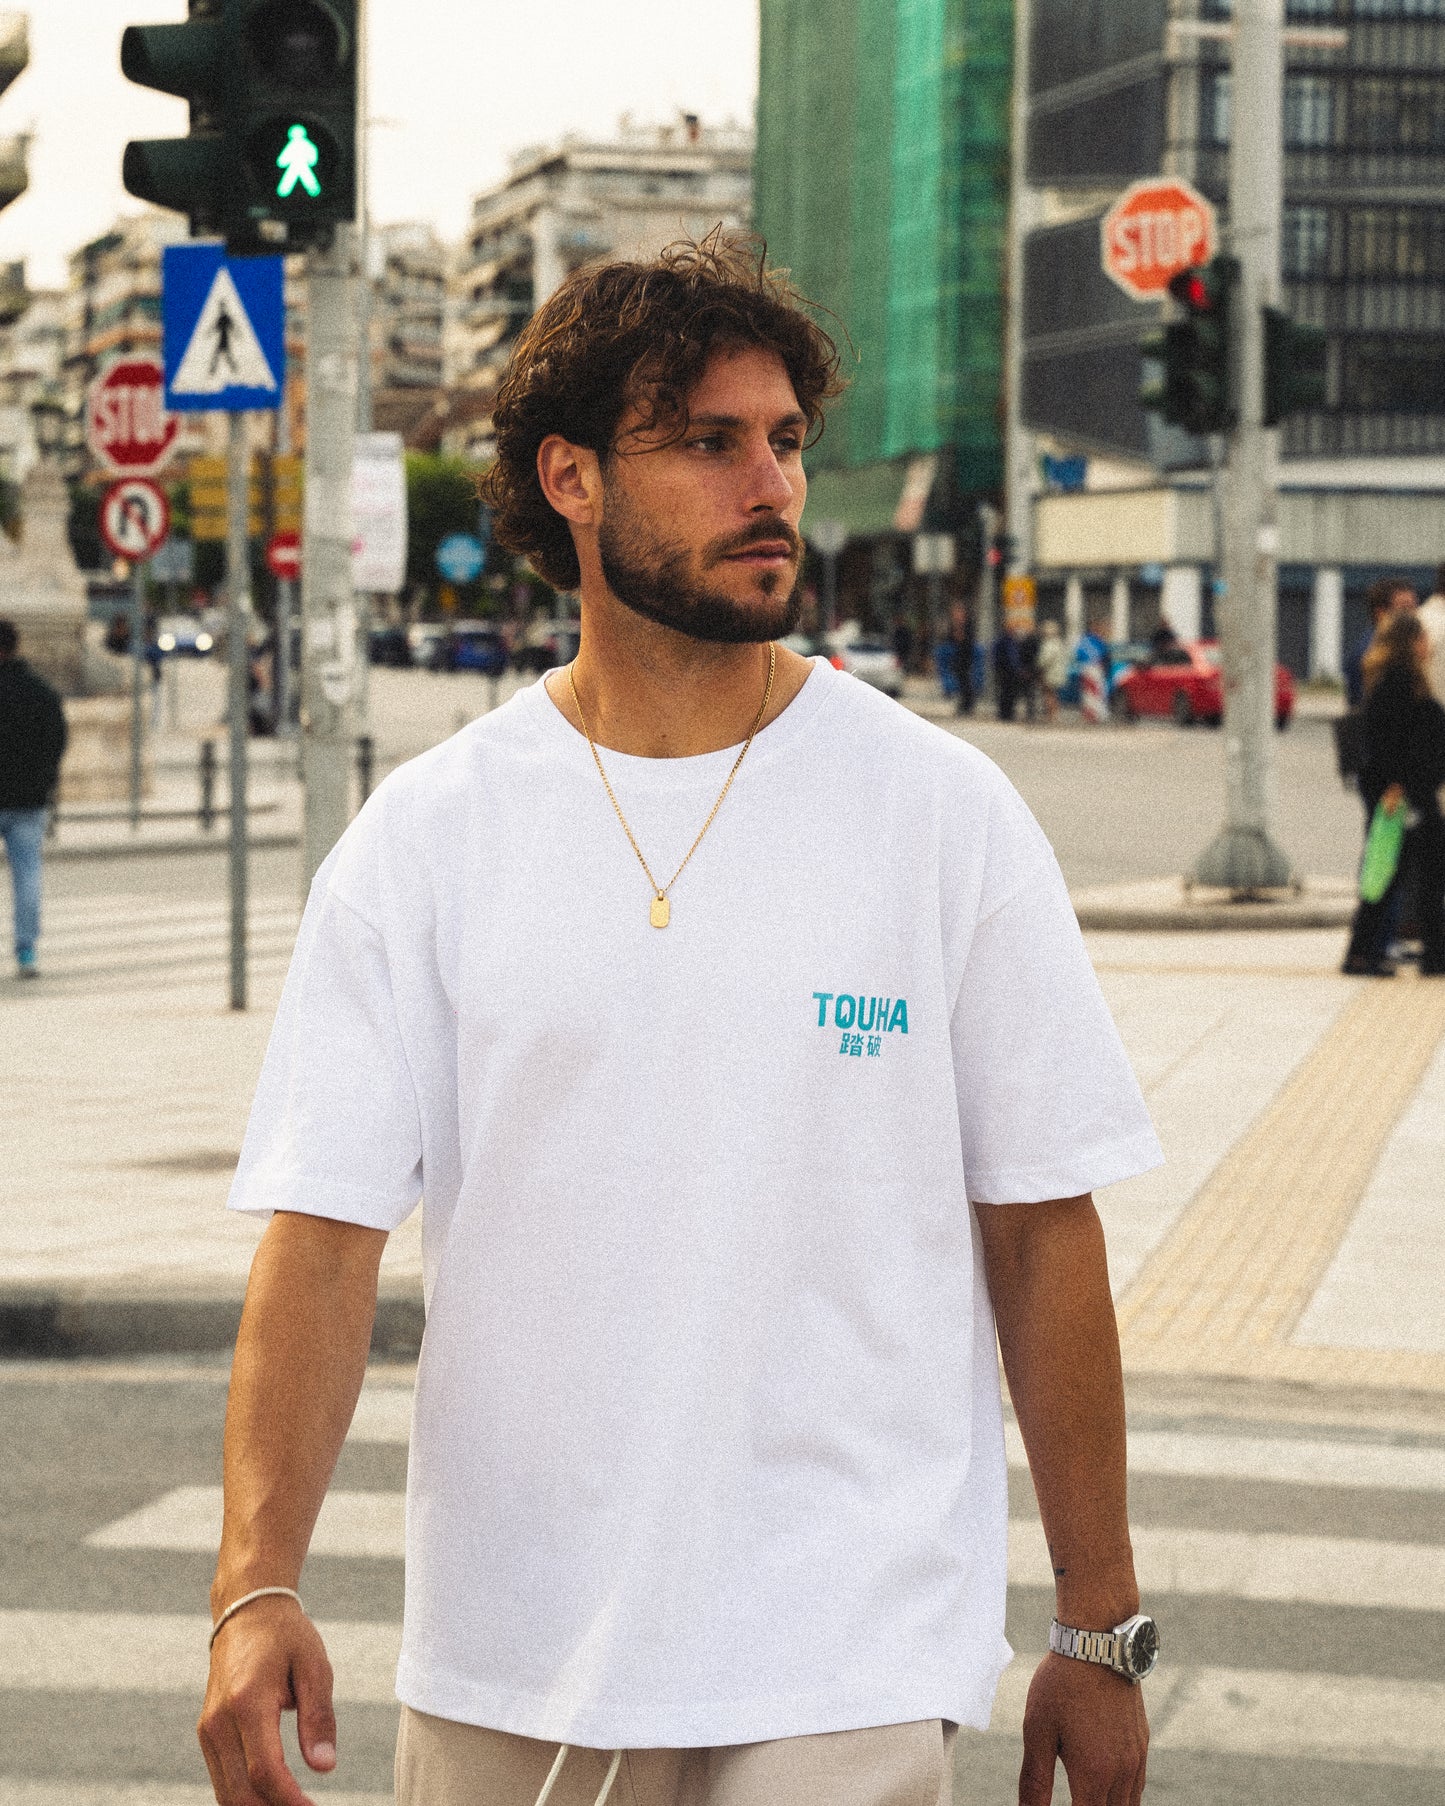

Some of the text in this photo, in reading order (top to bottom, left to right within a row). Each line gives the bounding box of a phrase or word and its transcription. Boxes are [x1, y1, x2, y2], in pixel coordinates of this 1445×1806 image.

[1111, 206, 1201, 270] STOP
[812, 992, 909, 1034] TOUHA
[839, 1033, 882, 1057] 踏破
